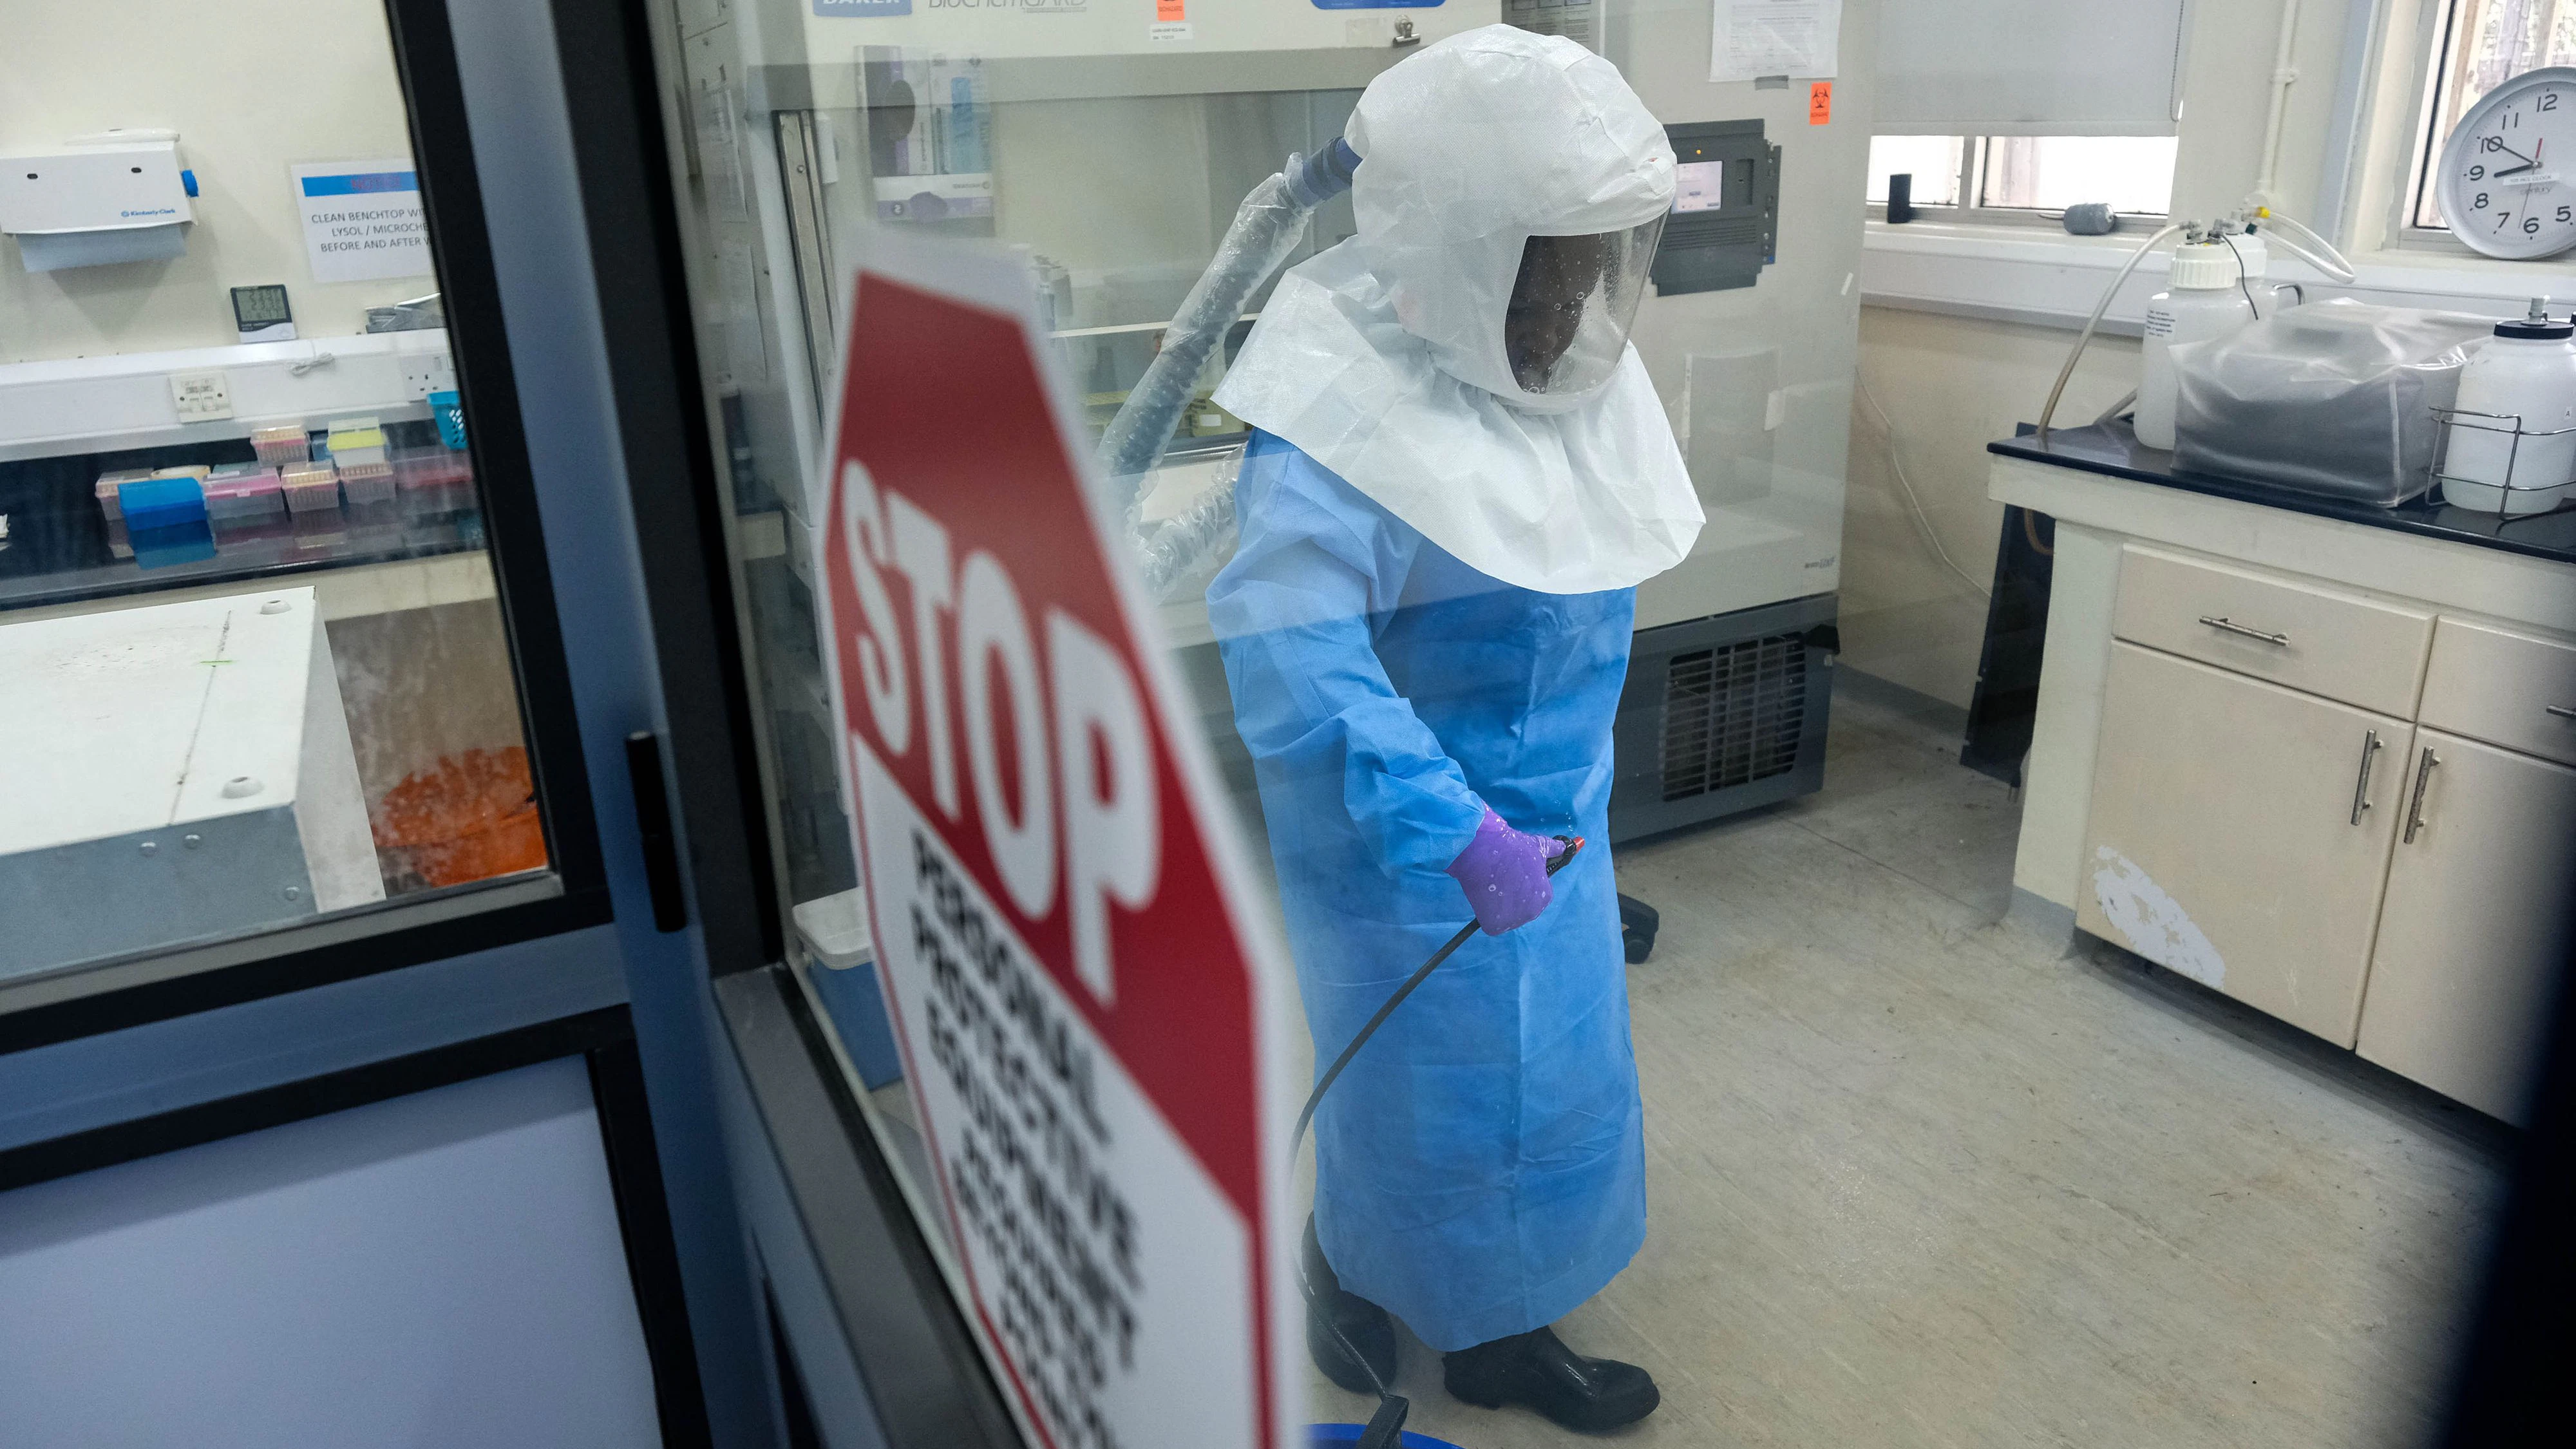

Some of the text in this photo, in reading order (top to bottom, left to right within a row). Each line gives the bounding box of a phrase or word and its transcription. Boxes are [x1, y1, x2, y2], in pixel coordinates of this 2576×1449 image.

[2537, 93, 2558, 113] 12
[2501, 112, 2519, 130] 11
[2480, 135, 2504, 154] 10
[2469, 165, 2485, 181] 9
[2474, 193, 2489, 209] 8
[311, 213, 345, 224] CLEAN
[348, 209, 404, 221] BENCHTOP
[2497, 211, 2510, 229] 7
[2555, 205, 2571, 222] 5
[331, 227, 363, 237] LYSOL
[2523, 216, 2539, 234] 6
[320, 240, 361, 253] BEFORE
[363, 238, 386, 250] AND
[389, 238, 421, 248] AFTER
[840, 457, 1161, 1012] STOP
[909, 826, 1115, 1150] PERSONAL
[909, 900, 1144, 1294] PROTECTIVE
